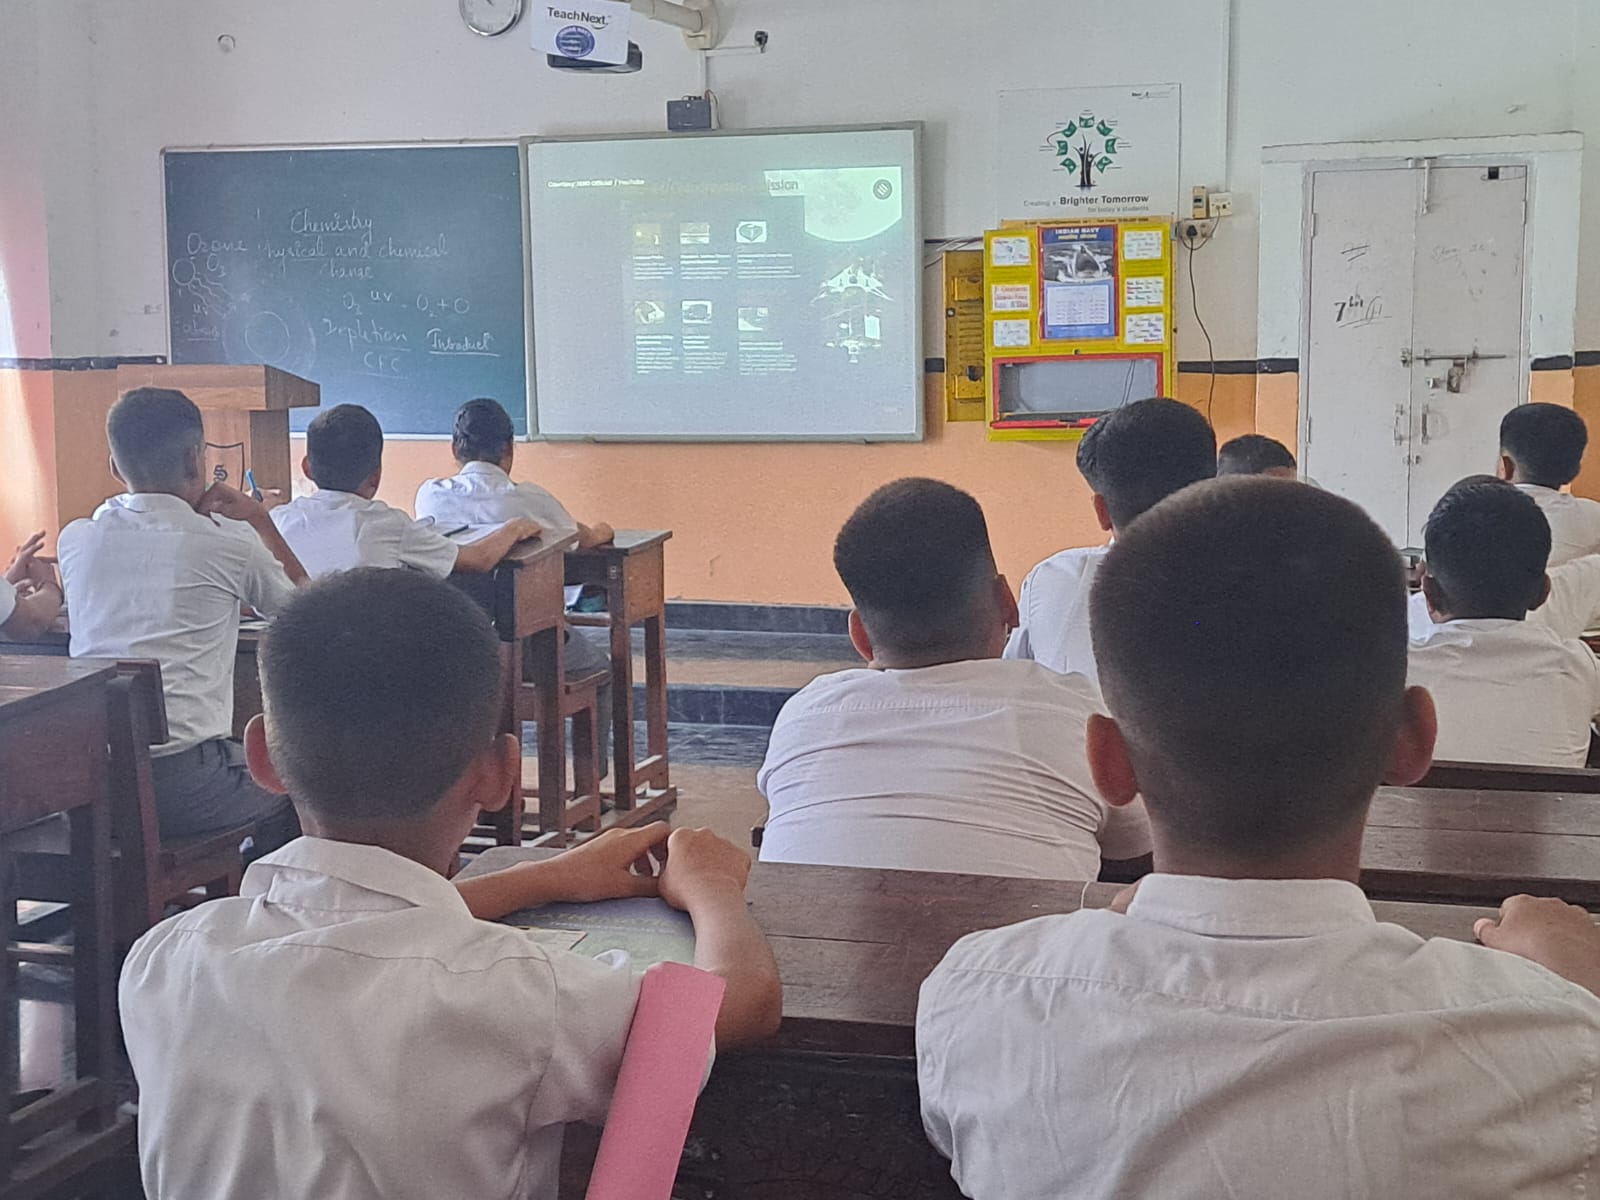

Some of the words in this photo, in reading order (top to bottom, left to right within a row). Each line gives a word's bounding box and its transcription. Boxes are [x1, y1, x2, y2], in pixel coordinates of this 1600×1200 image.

[767, 179, 799, 191] ission
[1059, 196, 1099, 207] Brighter
[1101, 195, 1150, 204] Tomorrow
